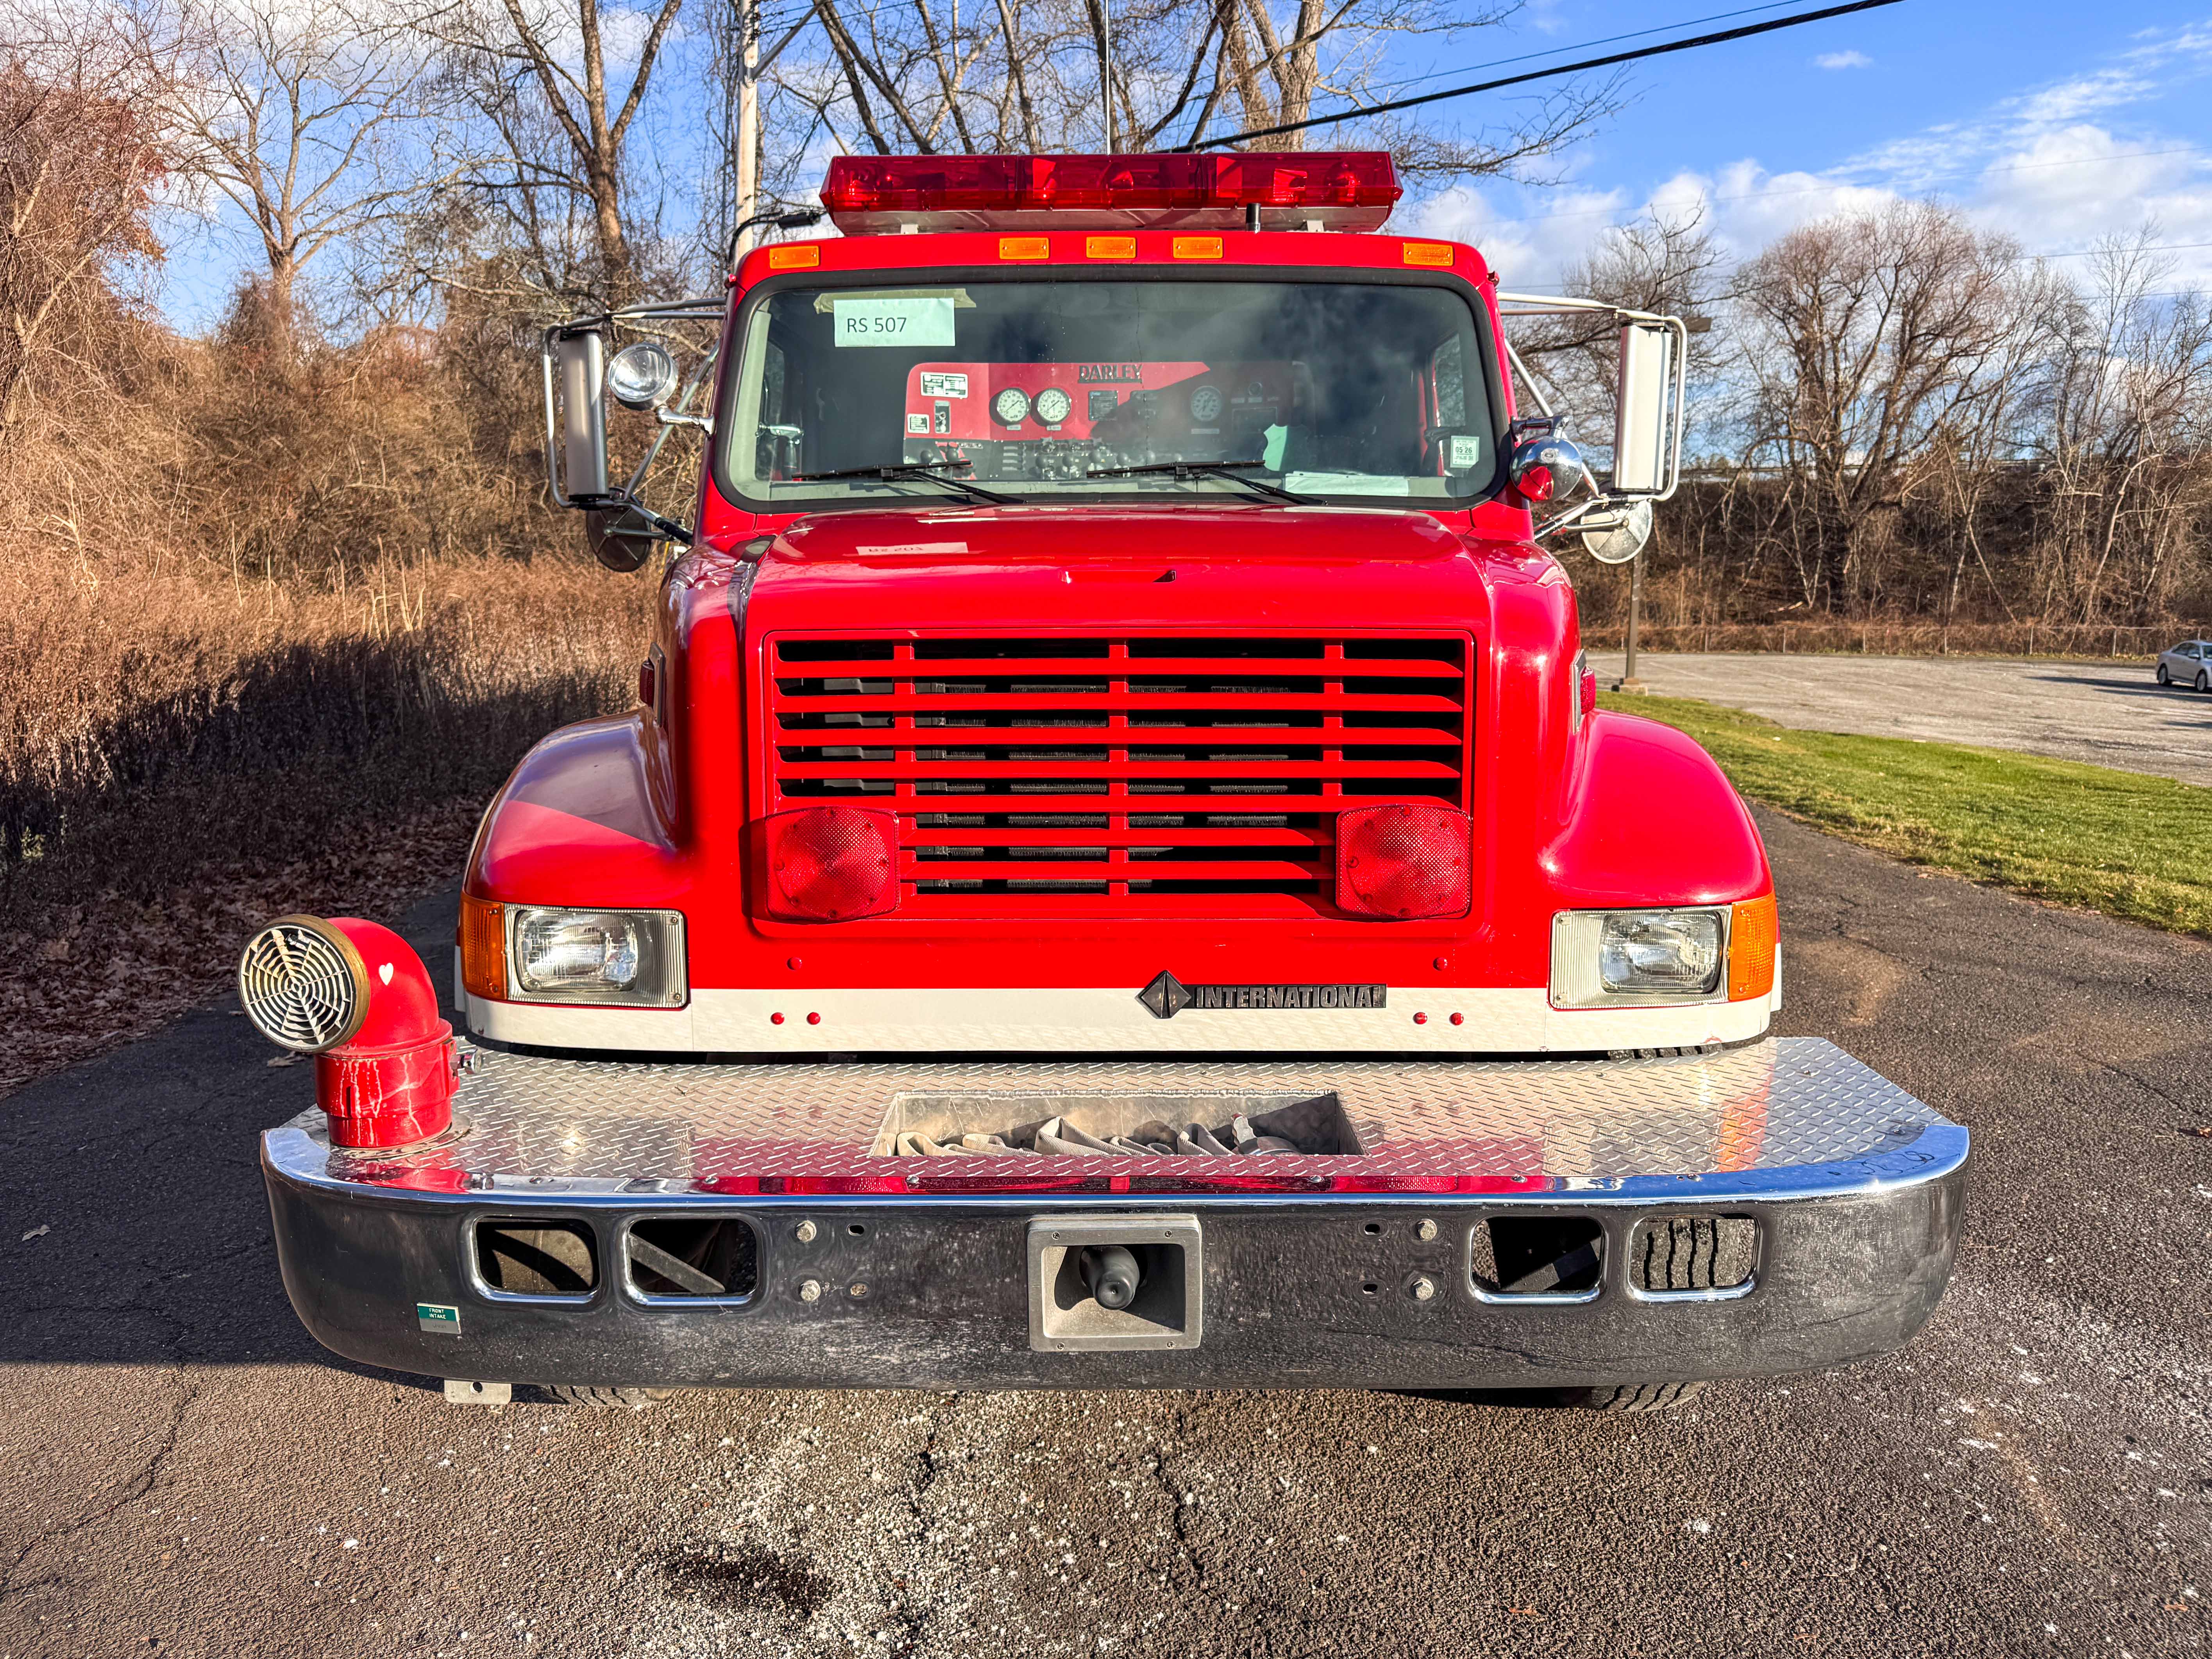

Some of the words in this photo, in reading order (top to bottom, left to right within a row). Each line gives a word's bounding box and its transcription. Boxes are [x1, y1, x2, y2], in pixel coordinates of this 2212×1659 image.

[847, 318, 868, 333] RS
[874, 317, 907, 333] 507
[1079, 364, 1142, 380] DARLEY
[1196, 986, 1384, 1008] INTERNATIONAL
